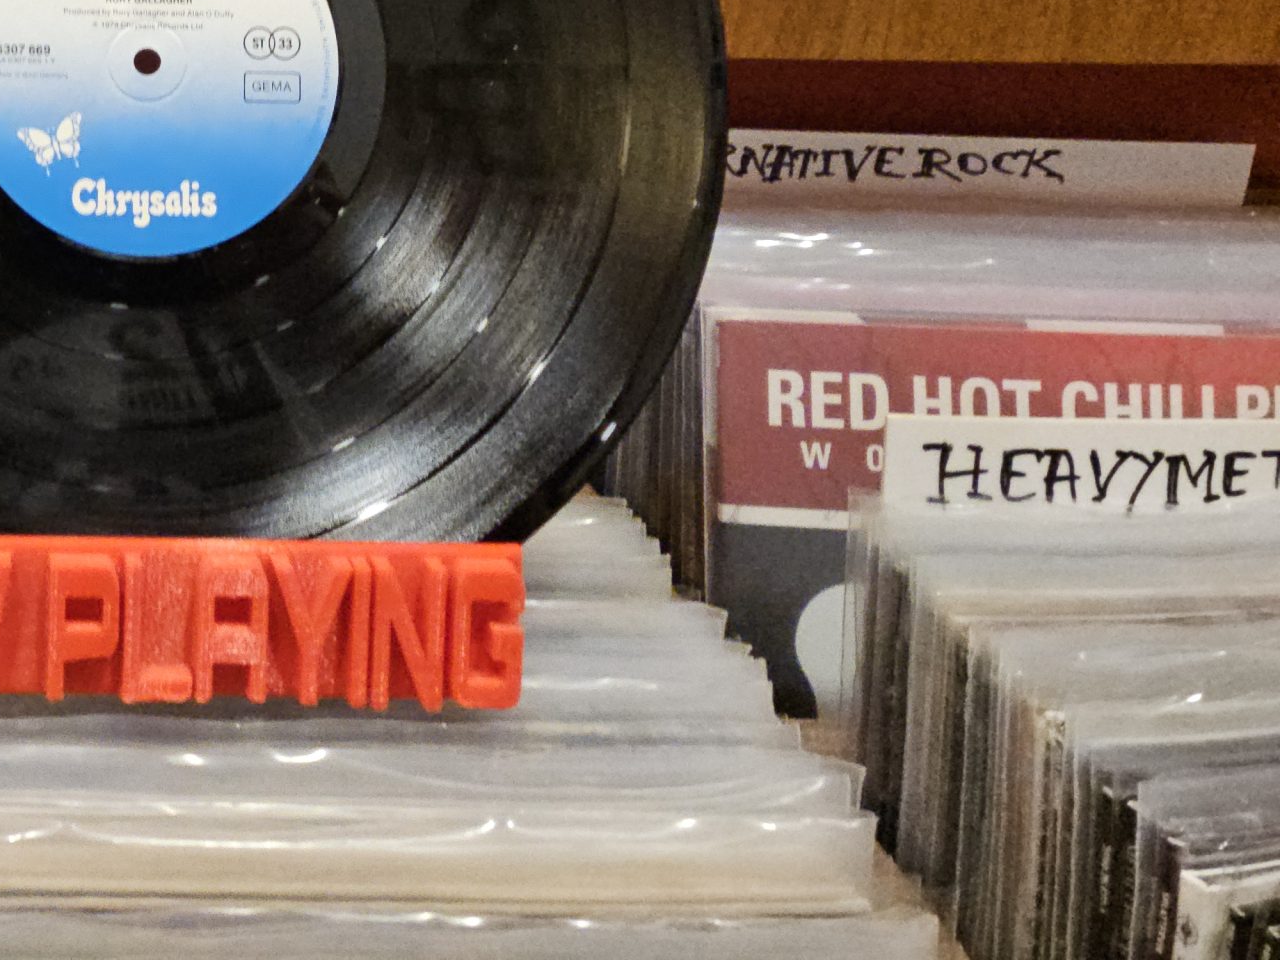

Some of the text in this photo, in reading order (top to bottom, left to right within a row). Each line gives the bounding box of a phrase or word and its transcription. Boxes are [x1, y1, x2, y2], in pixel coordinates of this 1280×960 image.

[252, 37, 293, 50] ST 33
[252, 80, 292, 93] GEMA
[912, 146, 1065, 184] ROCK
[71, 177, 218, 229] Chrysalis
[766, 368, 890, 431] RED
[912, 375, 1042, 418] HOT
[46, 548, 526, 711] PLAYING
